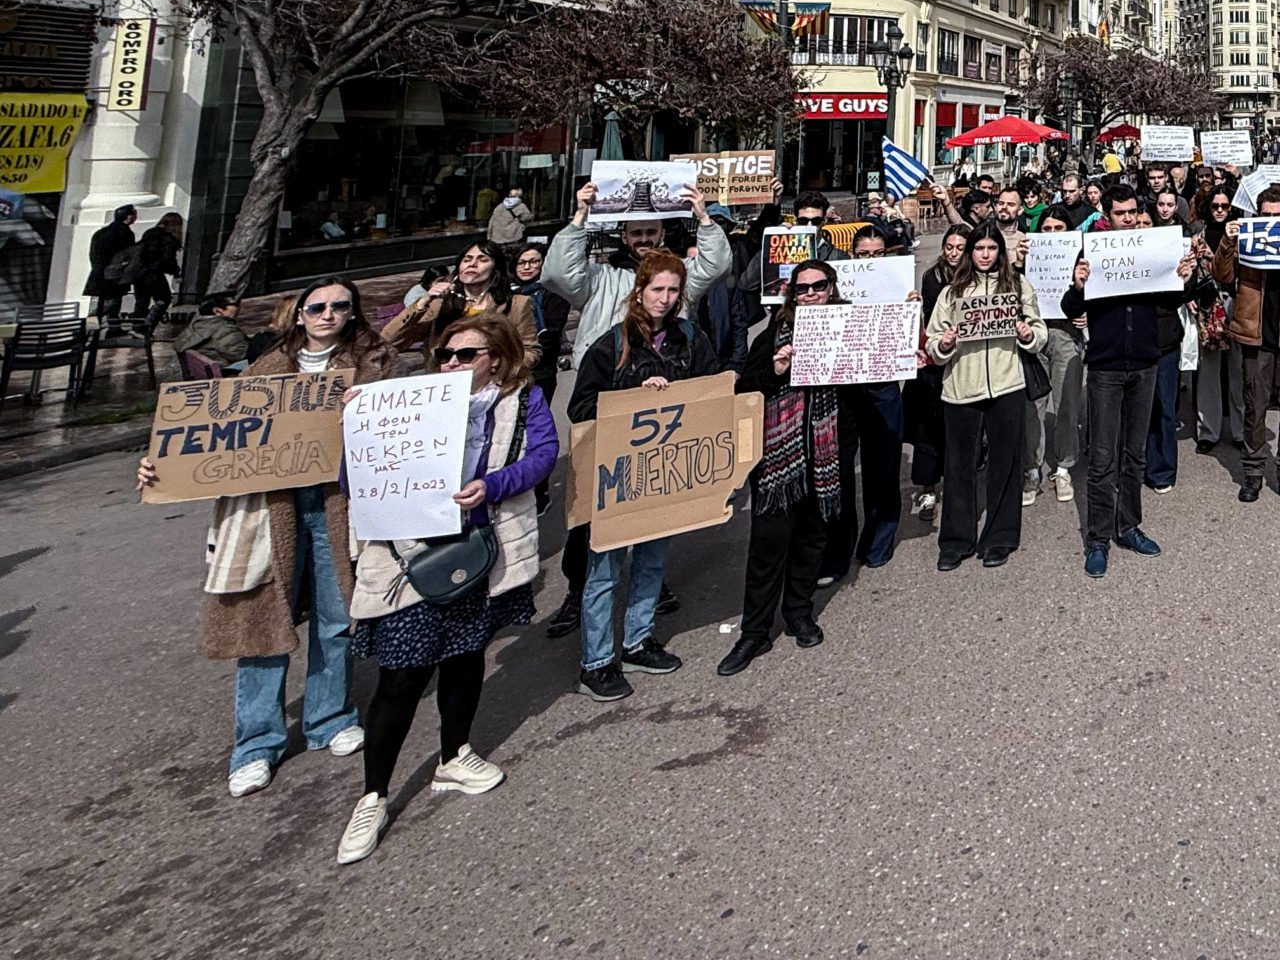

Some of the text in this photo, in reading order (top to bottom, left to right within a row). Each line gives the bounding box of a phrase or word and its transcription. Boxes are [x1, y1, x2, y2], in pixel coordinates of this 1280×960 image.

[116, 80, 135, 106] ORO
[838, 98, 888, 112] GUYS
[1090, 235, 1144, 252] ΣΤΕΙΛΕ
[834, 262, 876, 274] ΤΕΙΛΕ
[1102, 256, 1135, 270] ΟΤΑΝ
[841, 280, 856, 288] ΑΝ
[961, 294, 1018, 310] ΔΕΝ ΕΧΩ
[356, 384, 452, 415] ΕΙΜΑΣΤΕ
[377, 414, 421, 428] ΦΩΝΗ
[630, 404, 686, 446] 57
[374, 428, 409, 440] ΤΩΝ
[192, 432, 334, 484] GRECIA
[350, 436, 448, 464] ΝΕΚΡΩΝ
[374, 461, 400, 474] ΜΑΣ
[597, 430, 735, 512] MUERTOS
[358, 476, 447, 501] 28/2/2023
